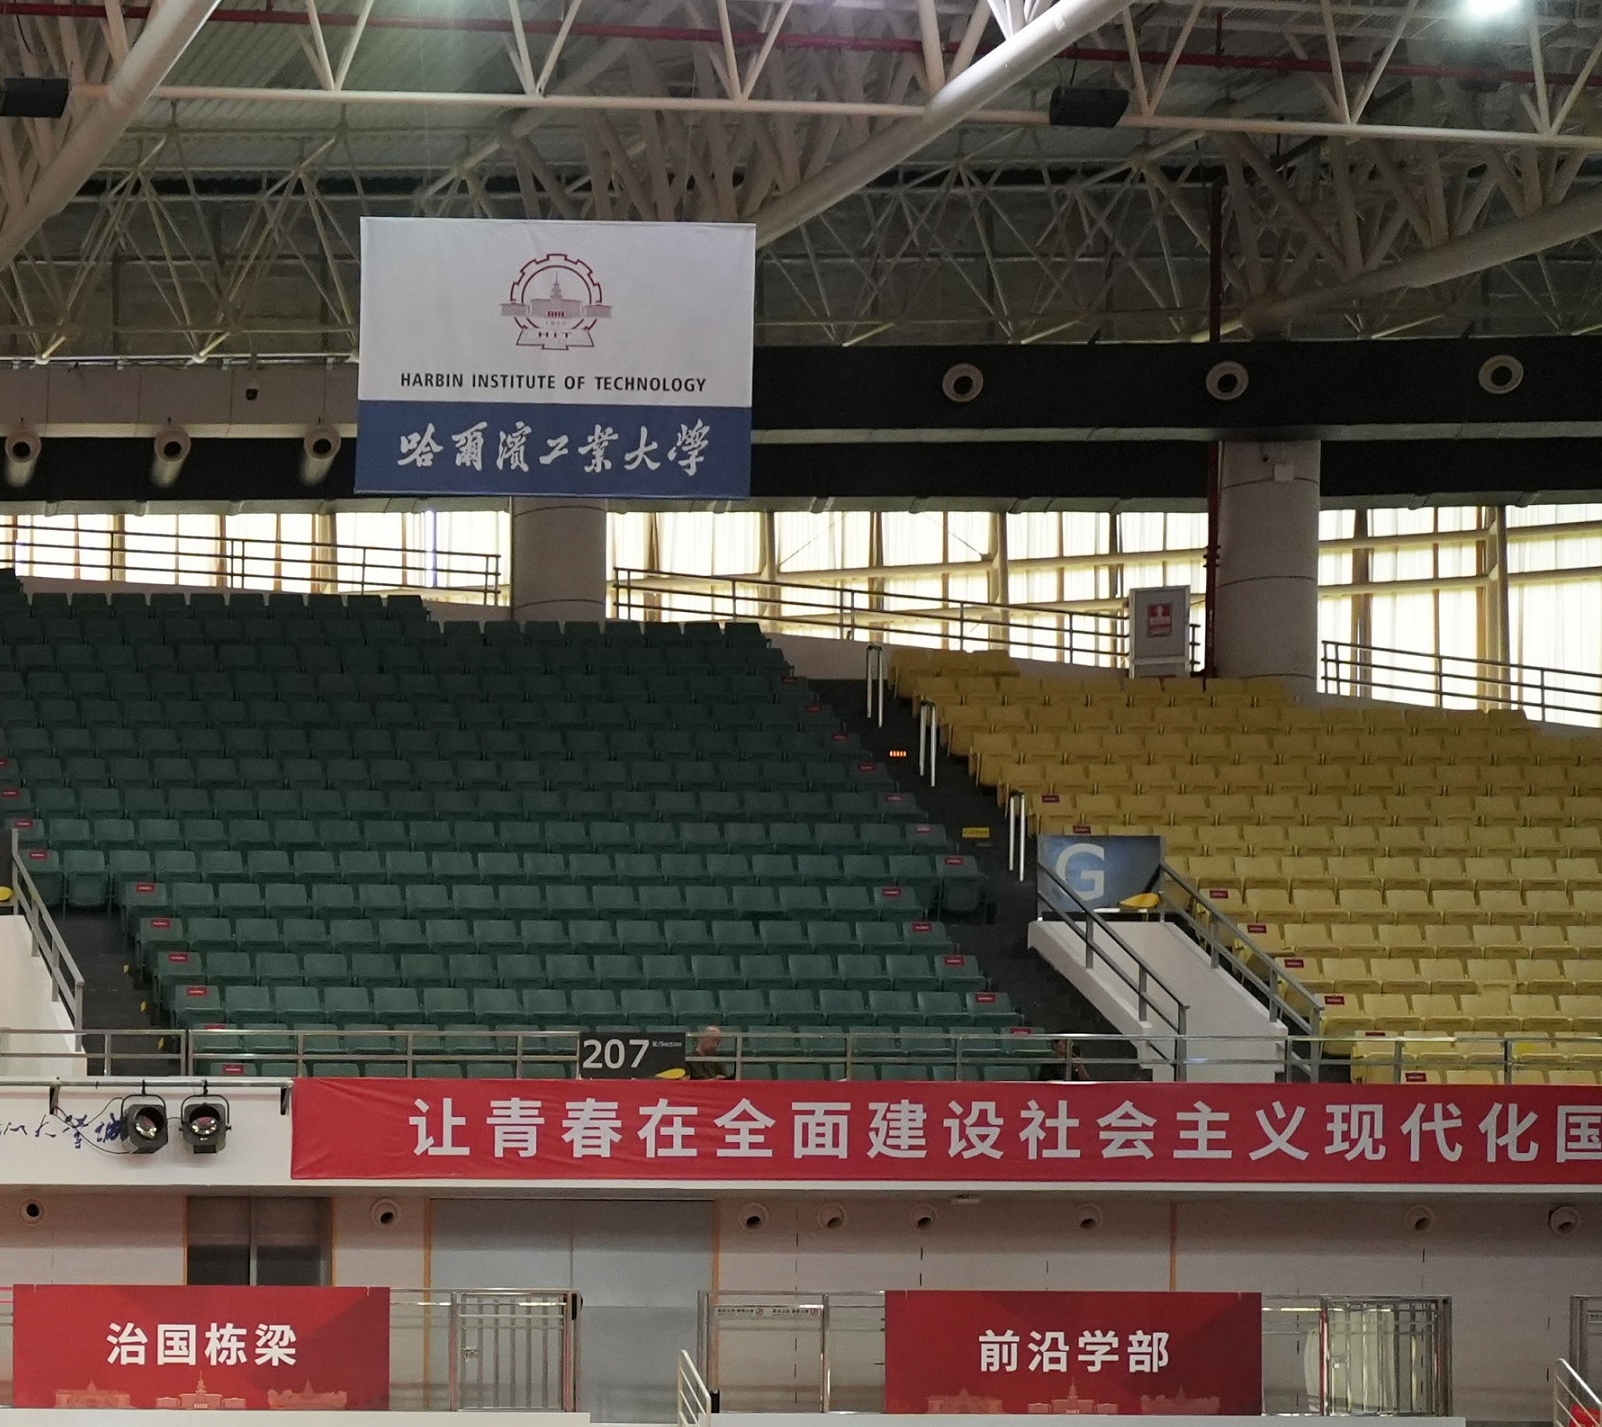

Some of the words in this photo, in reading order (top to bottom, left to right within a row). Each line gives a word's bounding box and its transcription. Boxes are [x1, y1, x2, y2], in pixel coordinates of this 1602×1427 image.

[400, 372, 464, 388] HARBIN
[471, 373, 556, 389] INSTITUTE
[563, 375, 586, 390] OF
[594, 375, 707, 393] TECHNOLOGY
[1056, 843, 1105, 900] G
[582, 1038, 650, 1069] 207
[408, 1097, 1602, 1163] 让青春在全面建设社会主义现代化国
[106, 1322, 298, 1367] 治国栋梁
[978, 1329, 1171, 1374] 前沿学部
